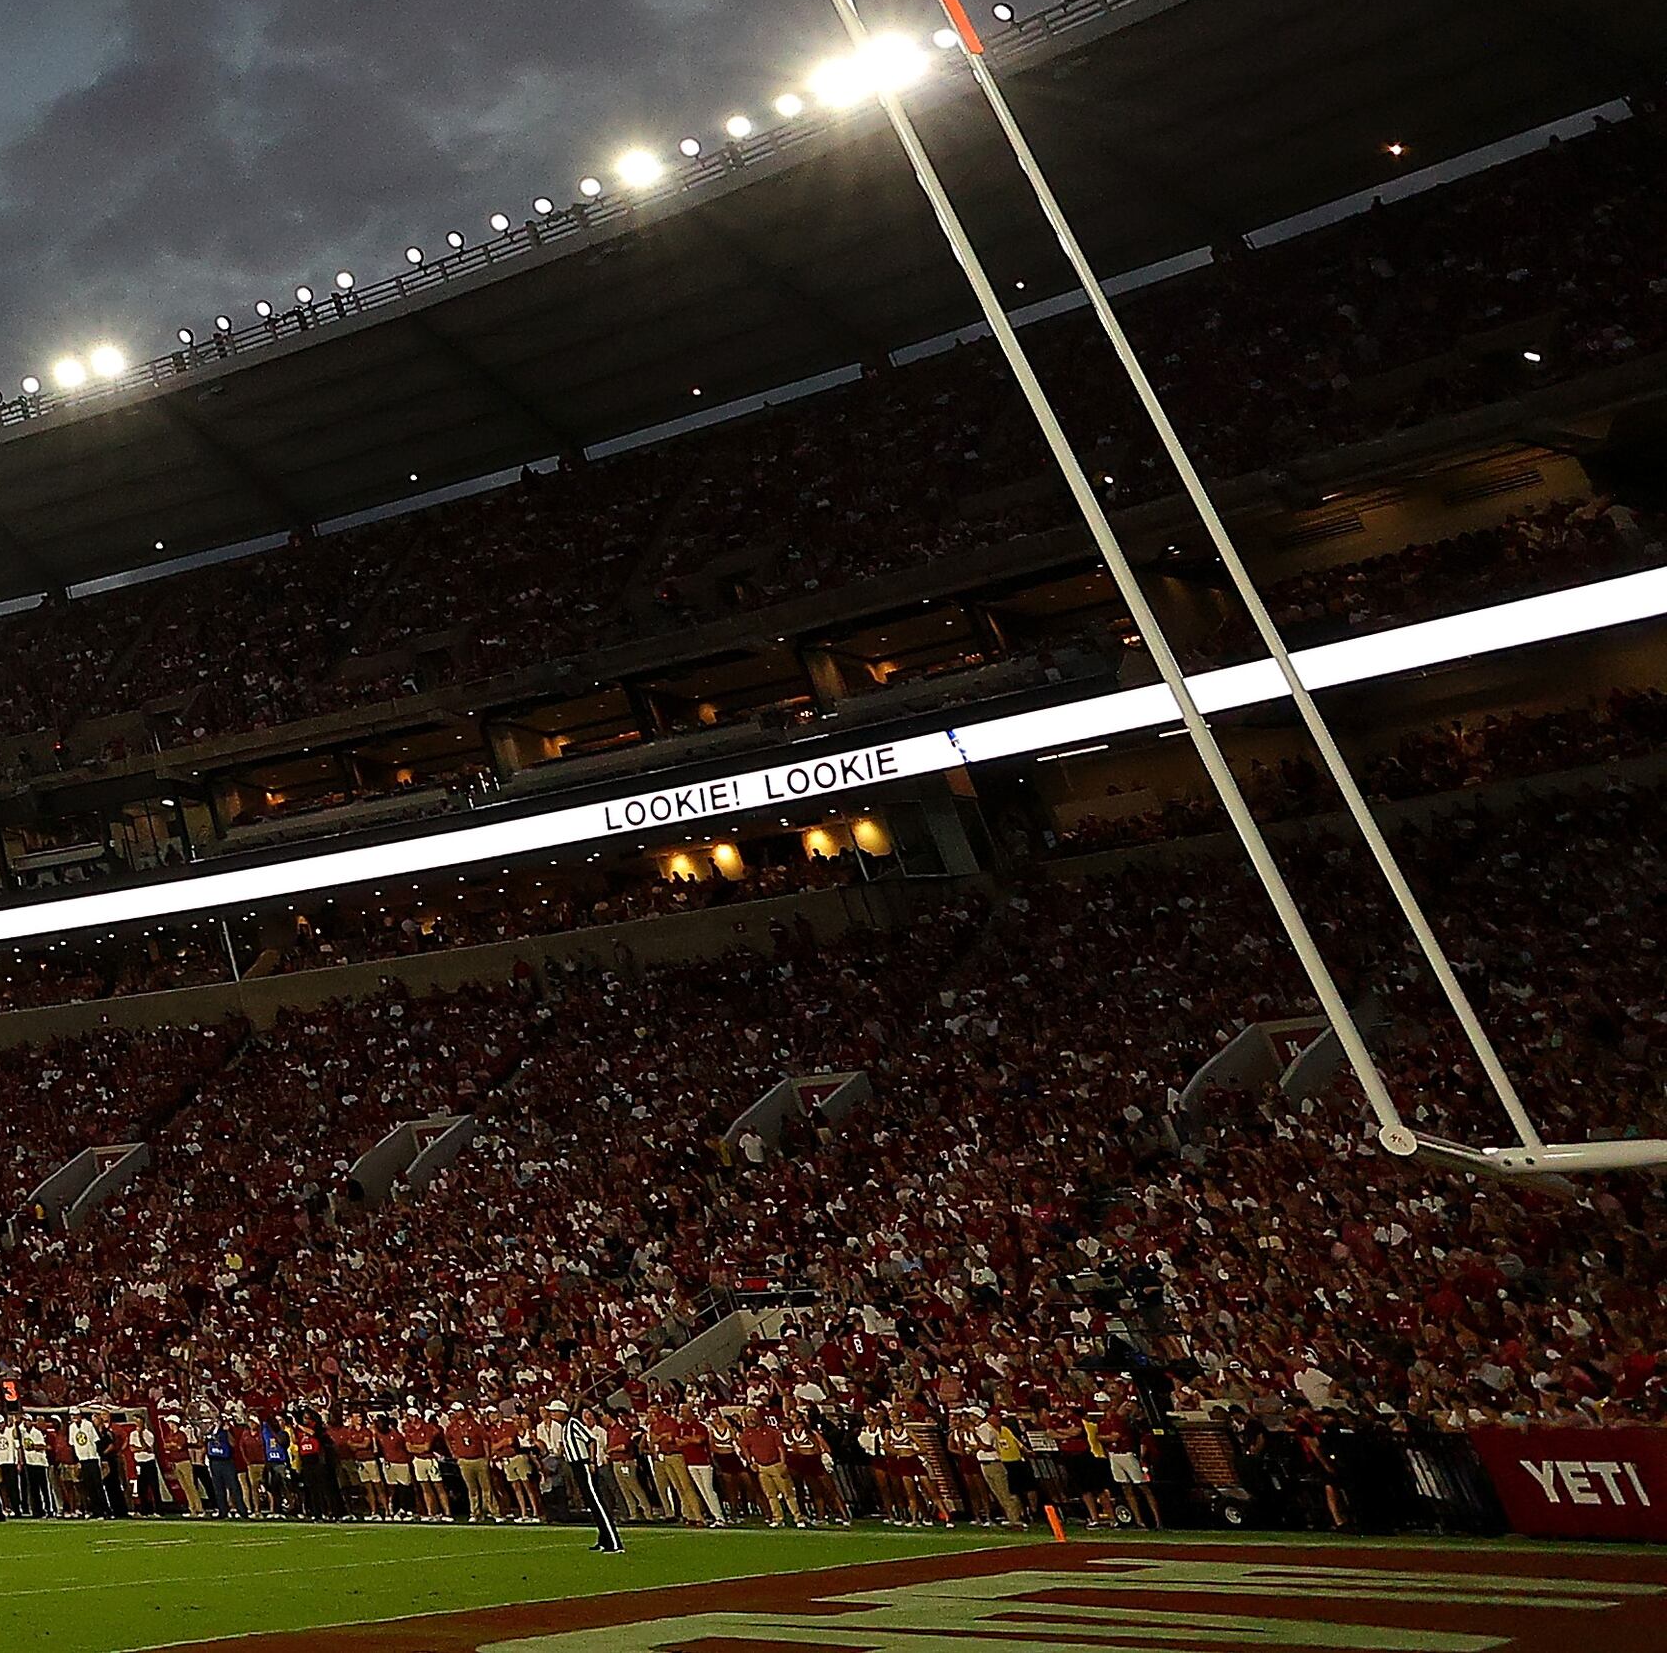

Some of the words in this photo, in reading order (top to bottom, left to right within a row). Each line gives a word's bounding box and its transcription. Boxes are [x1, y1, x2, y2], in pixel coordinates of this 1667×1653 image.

[605, 780, 741, 830] LOOKIE!
[764, 747, 900, 799] LOOKIE
[854, 1338, 864, 1353] 8
[2, 1381, 18, 1401] 3
[1519, 1460, 1650, 1507] YETI
